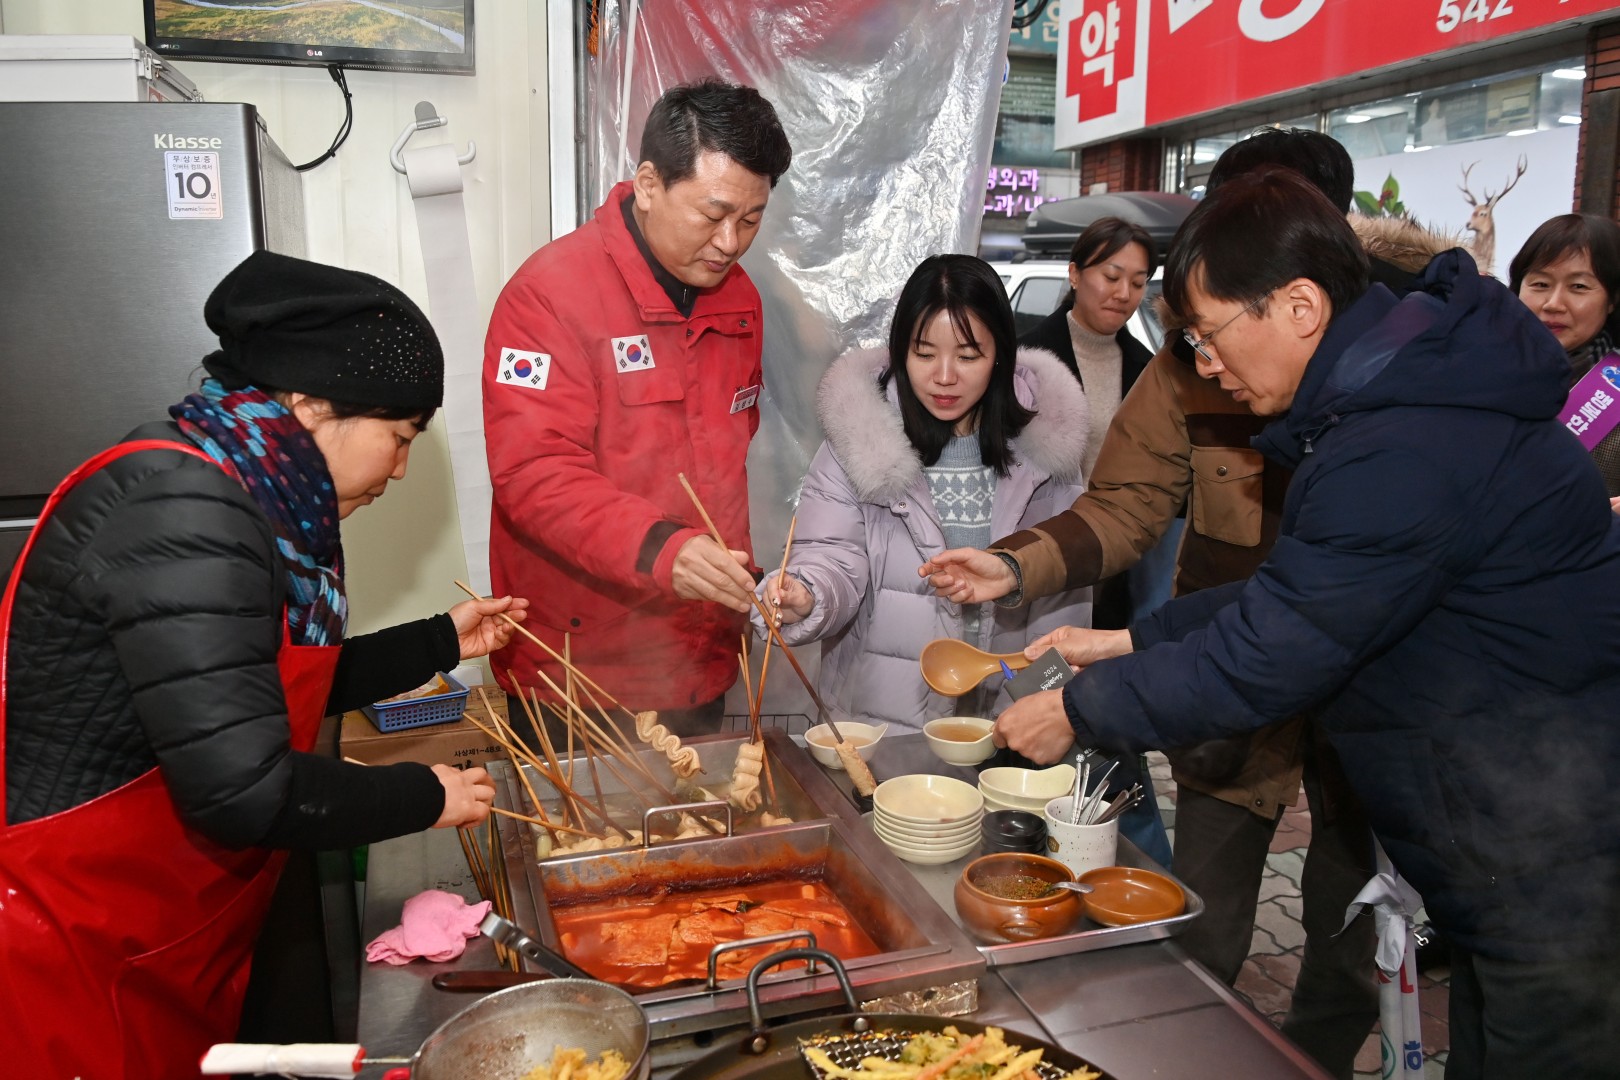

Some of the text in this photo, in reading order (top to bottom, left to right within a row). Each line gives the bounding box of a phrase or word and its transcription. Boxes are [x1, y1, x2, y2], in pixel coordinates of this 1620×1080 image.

[1080, 0, 1121, 88] 약
[154, 133, 222, 149] Klasse
[174, 172, 211, 199] 10
[1566, 389, 1614, 436] 행복한
[1043, 664, 1058, 678] 2024
